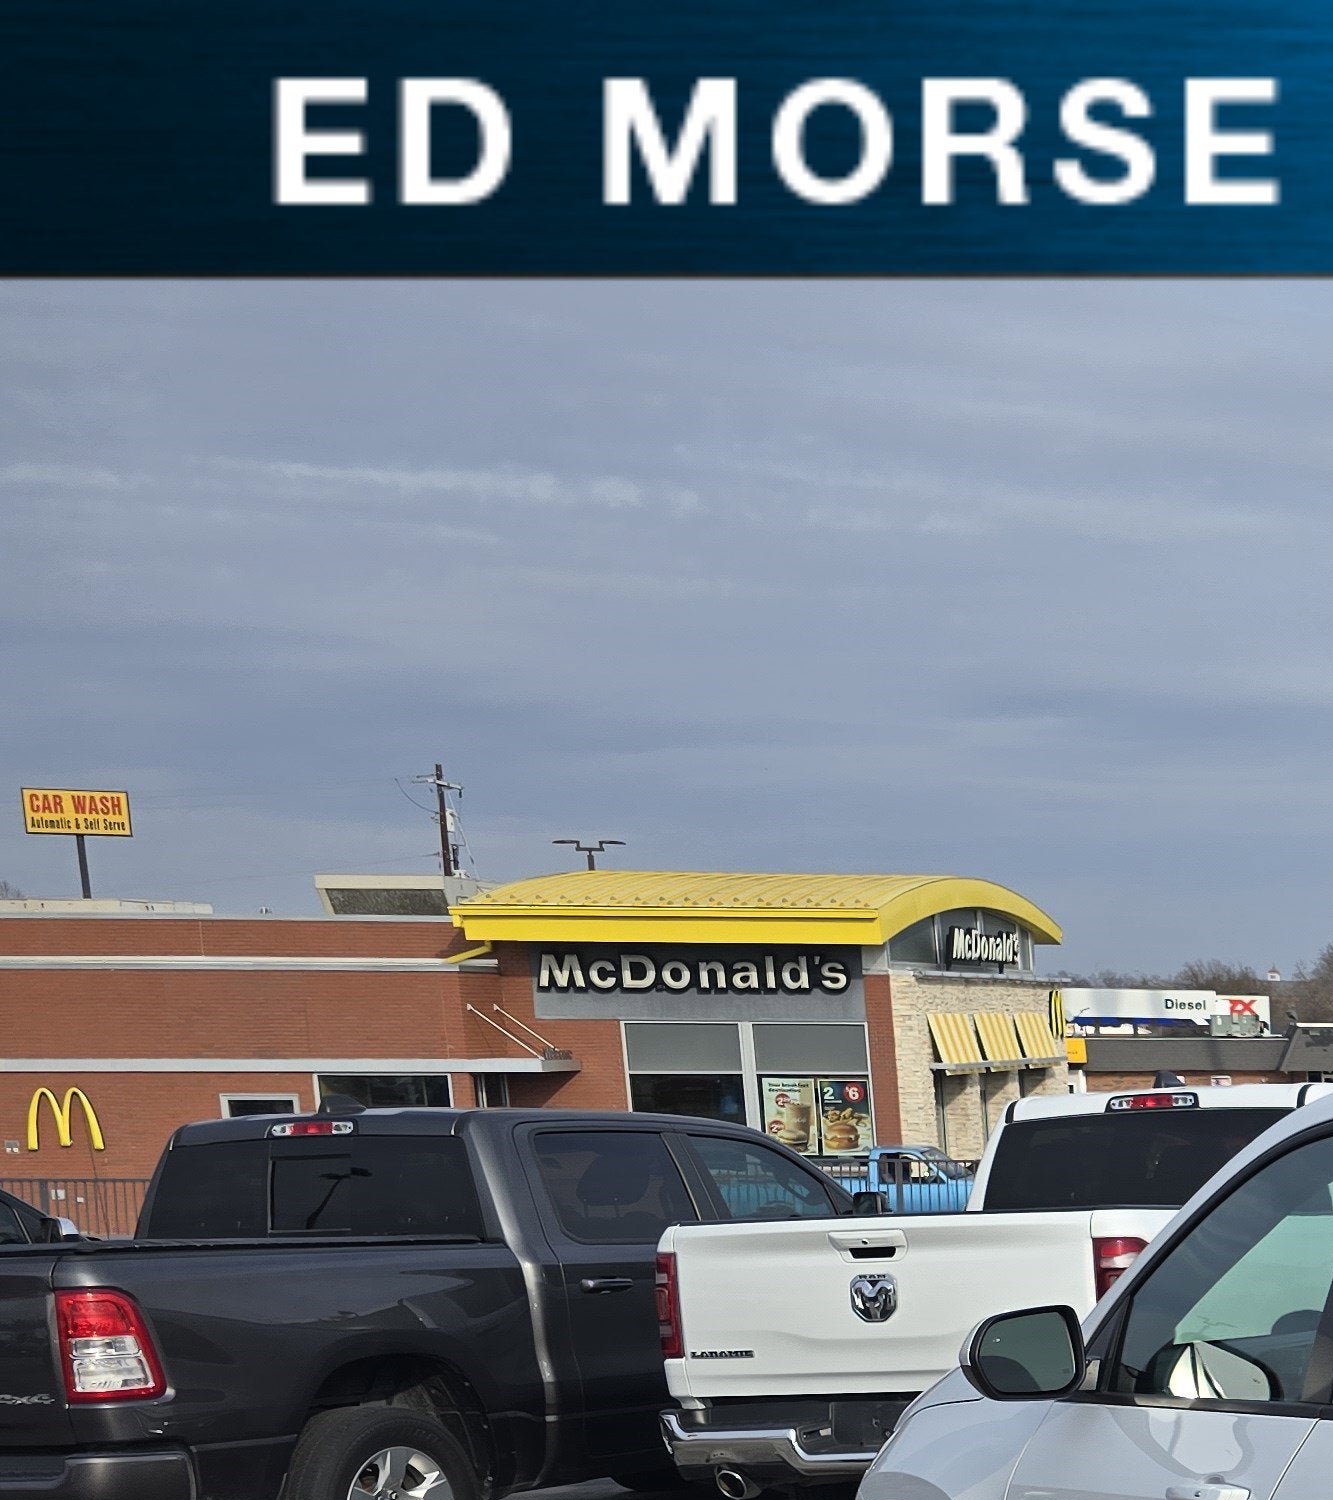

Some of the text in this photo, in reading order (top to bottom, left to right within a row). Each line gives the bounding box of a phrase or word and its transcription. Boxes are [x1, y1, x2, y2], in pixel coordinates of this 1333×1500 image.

[30, 794, 122, 816] CAR WASH
[31, 817, 71, 829] Automatic
[84, 818, 100, 830] Self
[104, 819, 126, 831] Serve
[952, 927, 1020, 962] McDonald's
[539, 953, 848, 990] McDonald's
[1164, 998, 1207, 1010] Diesel
[823, 1087, 834, 1100] 2
[690, 1350, 755, 1359] LARAMIE
